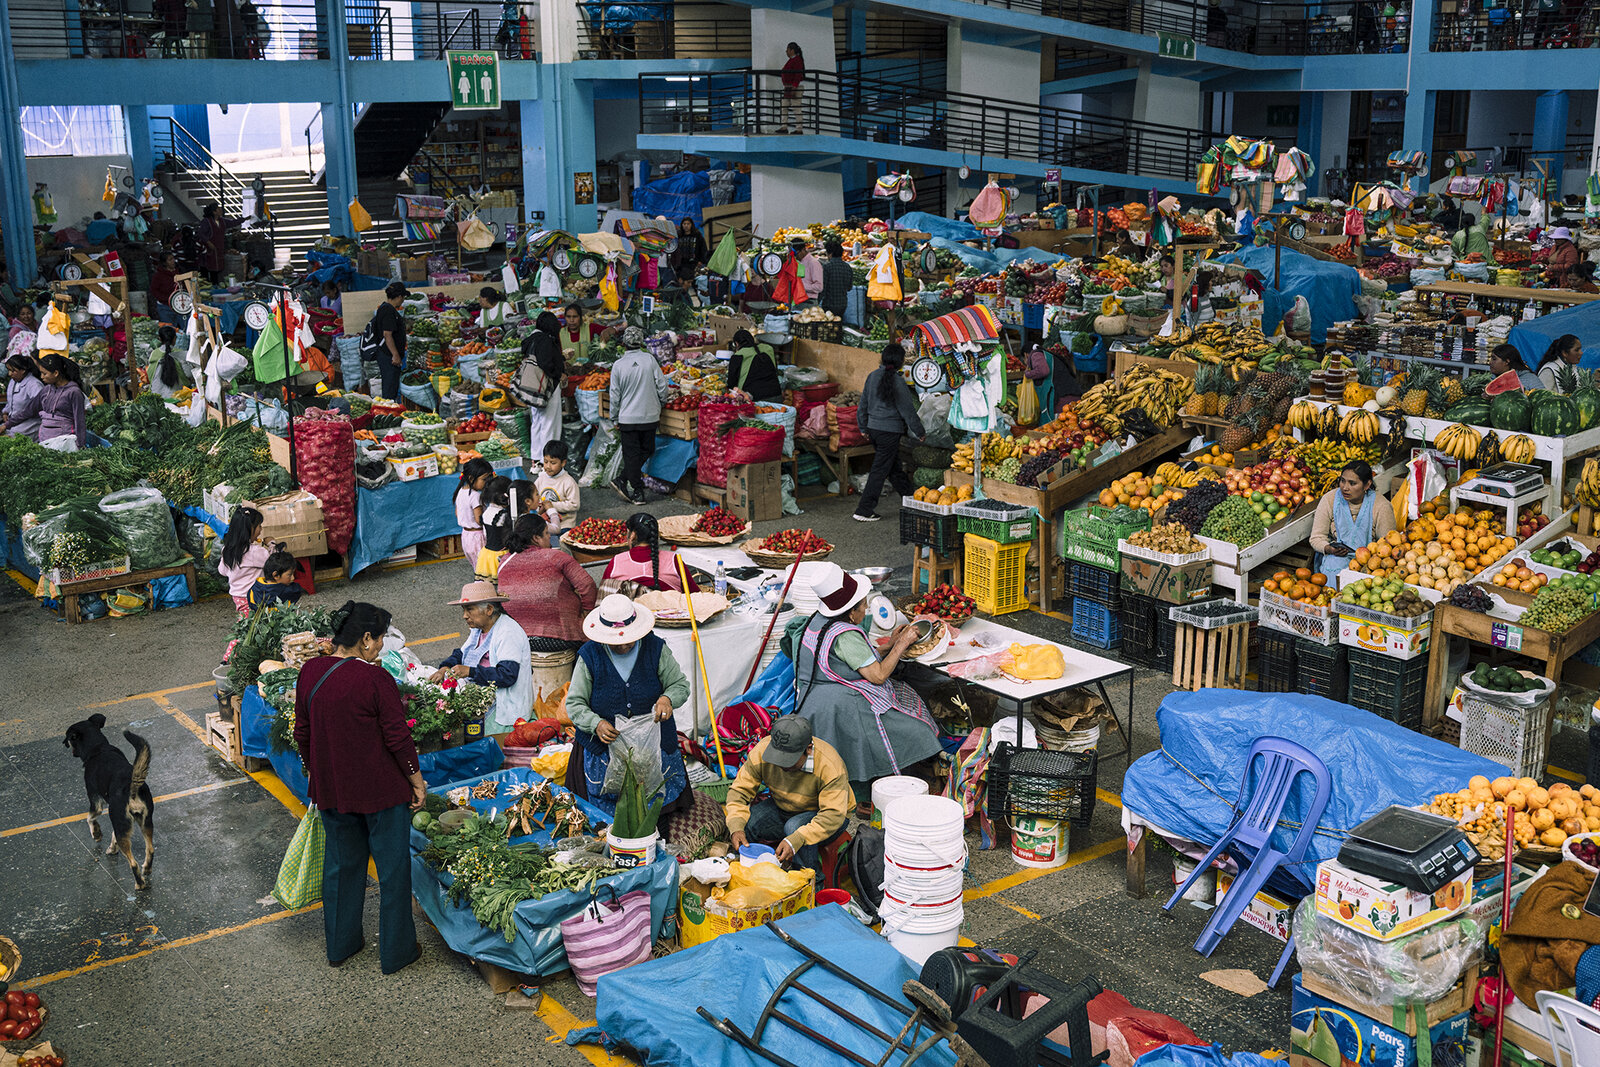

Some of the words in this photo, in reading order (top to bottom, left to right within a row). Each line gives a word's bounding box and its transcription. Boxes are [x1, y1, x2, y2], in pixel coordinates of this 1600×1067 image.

[460, 54, 493, 65] BAÑOS
[614, 854, 637, 867] Fast
[1451, 1017, 1468, 1030] Pears
[1371, 1024, 1405, 1049] Pears
